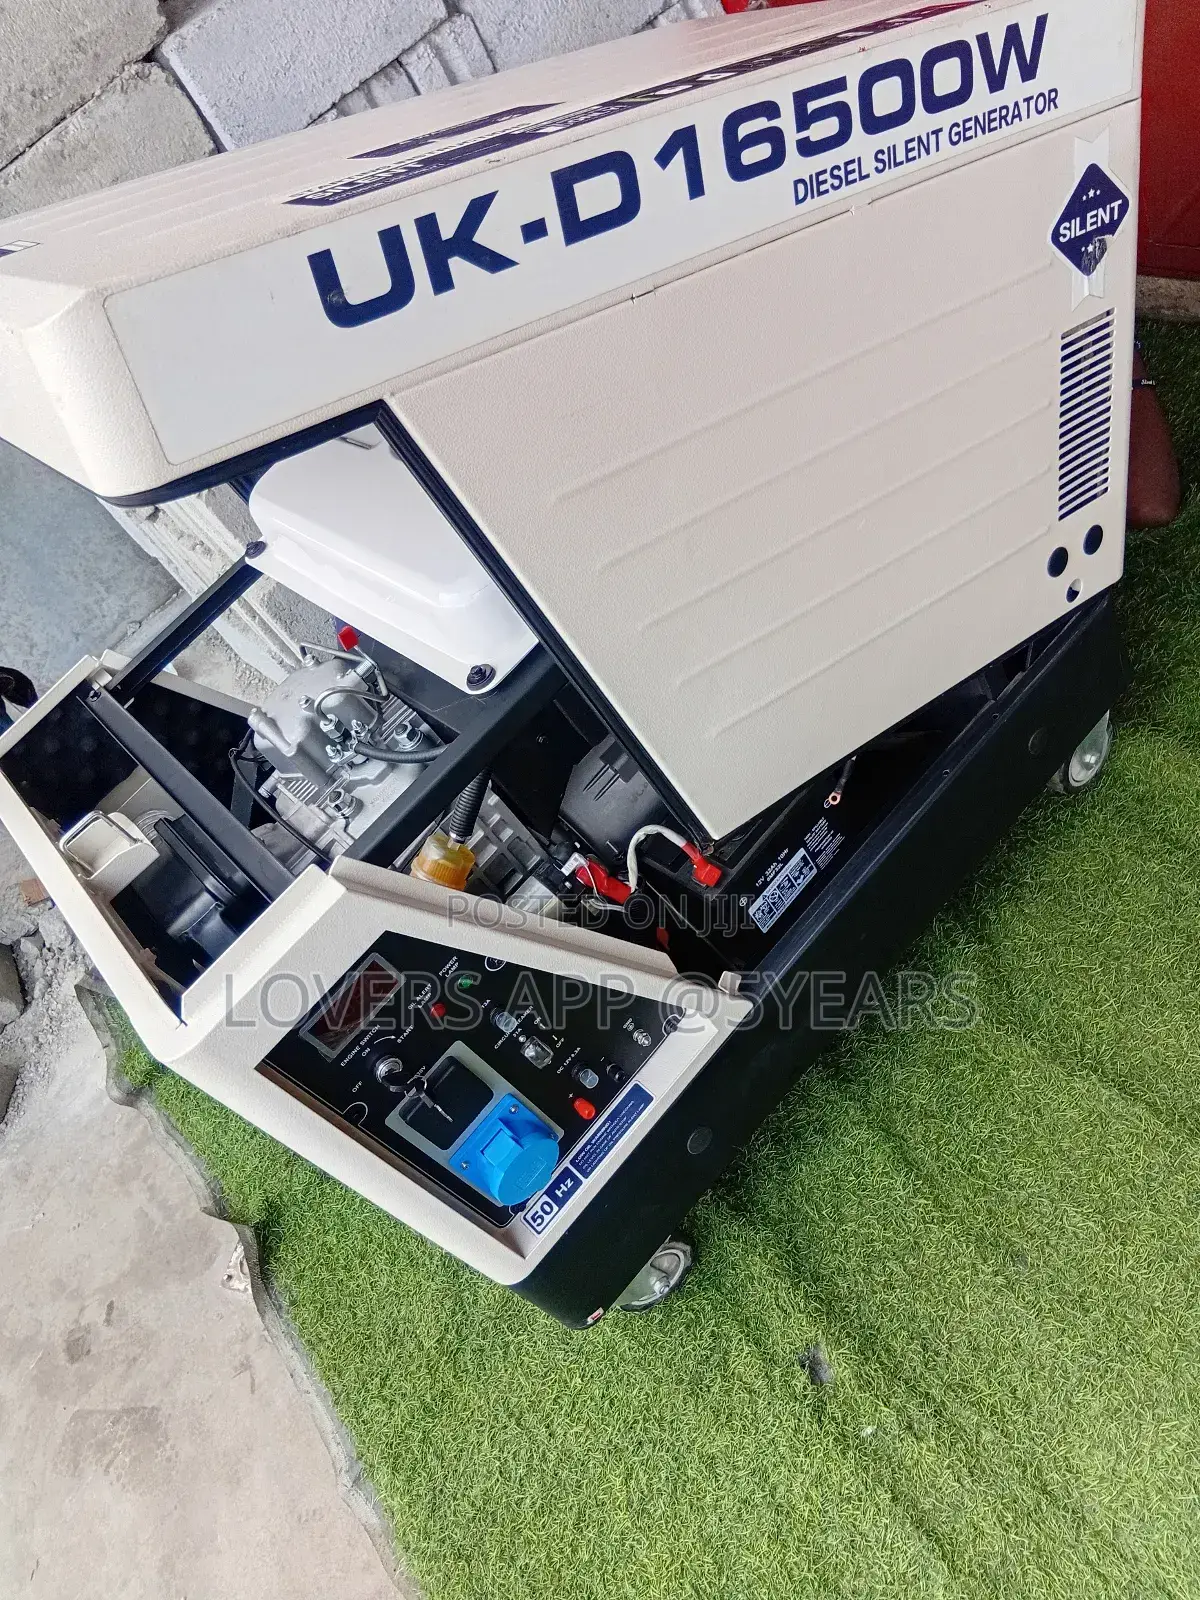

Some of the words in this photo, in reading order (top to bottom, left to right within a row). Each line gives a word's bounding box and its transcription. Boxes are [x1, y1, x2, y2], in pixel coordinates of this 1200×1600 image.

[794, 156, 870, 206] DIESEL
[874, 130, 944, 174] SILENT
[948, 88, 1058, 146] GENERATOR
[306, 13, 1049, 329] UK-D16500W
[306, 163, 424, 199] SILENT
[1058, 199, 1123, 244] SILENT
[438, 956, 458, 977] POWER
[445, 962, 459, 978] LAMP
[416, 983, 432, 1002] ALERT
[533, 1017, 542, 1025] ON
[396, 1025, 414, 1044] START
[340, 1046, 360, 1067] ENGINE
[360, 1024, 380, 1046] SWITCH
[361, 1047, 370, 1057] ON
[352, 1080, 363, 1093] OFF
[575, 1151, 585, 1162] LOW
[530, 1200, 554, 1227] 50
[555, 1178, 574, 1197] Hz
